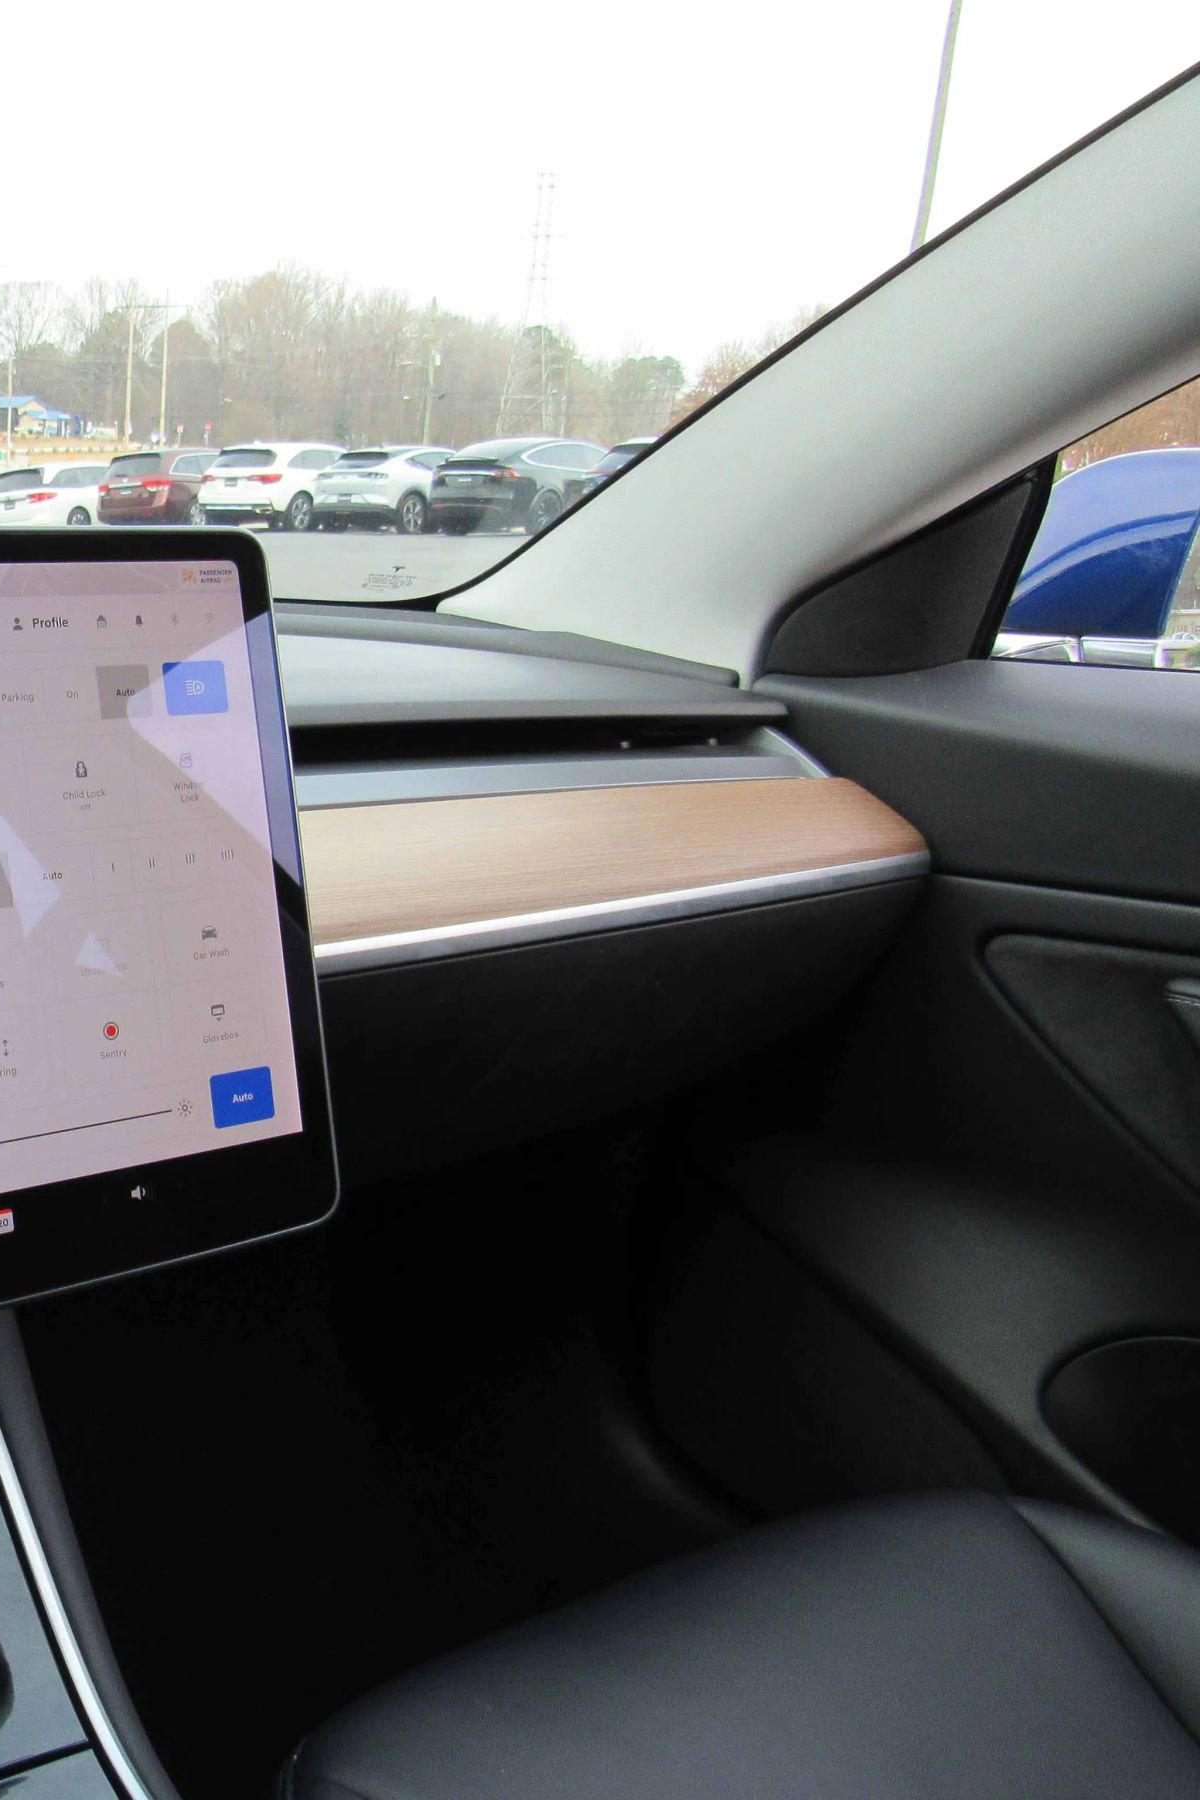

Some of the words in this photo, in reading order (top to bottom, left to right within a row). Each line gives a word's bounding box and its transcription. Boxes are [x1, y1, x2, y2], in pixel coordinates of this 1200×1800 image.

[32, 617, 69, 629] Profile
[1, 691, 35, 704] Parking
[66, 690, 79, 700] On
[115, 687, 136, 698] Auto
[62, 790, 84, 801] Child
[86, 788, 106, 799] Lock
[41, 870, 63, 882] Auto
[193, 950, 207, 961] Car
[208, 948, 230, 960] Wash
[99, 1047, 128, 1061] Sentry
[231, 1091, 254, 1104] Auto
